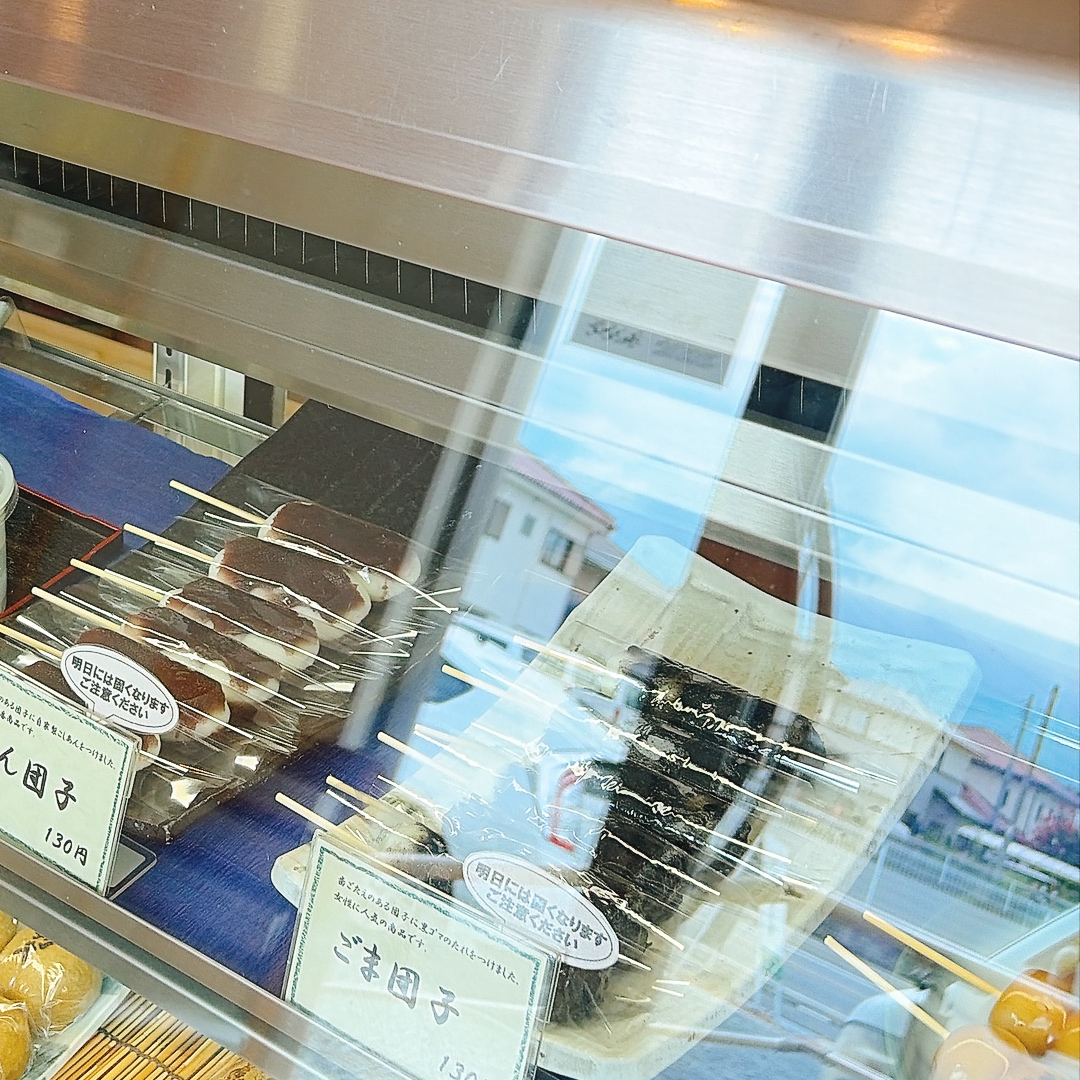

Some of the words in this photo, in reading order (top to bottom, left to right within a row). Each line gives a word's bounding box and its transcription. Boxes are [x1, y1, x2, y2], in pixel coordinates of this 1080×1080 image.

[71, 655, 170, 716] 明日には固くなります
[79, 676, 149, 720] ご注意ください
[44, 827, 88, 867] 130円
[474, 861, 609, 948] 明日には固くなります
[485, 886, 580, 950] ご注意ください
[333, 930, 460, 1025] ごま団子
